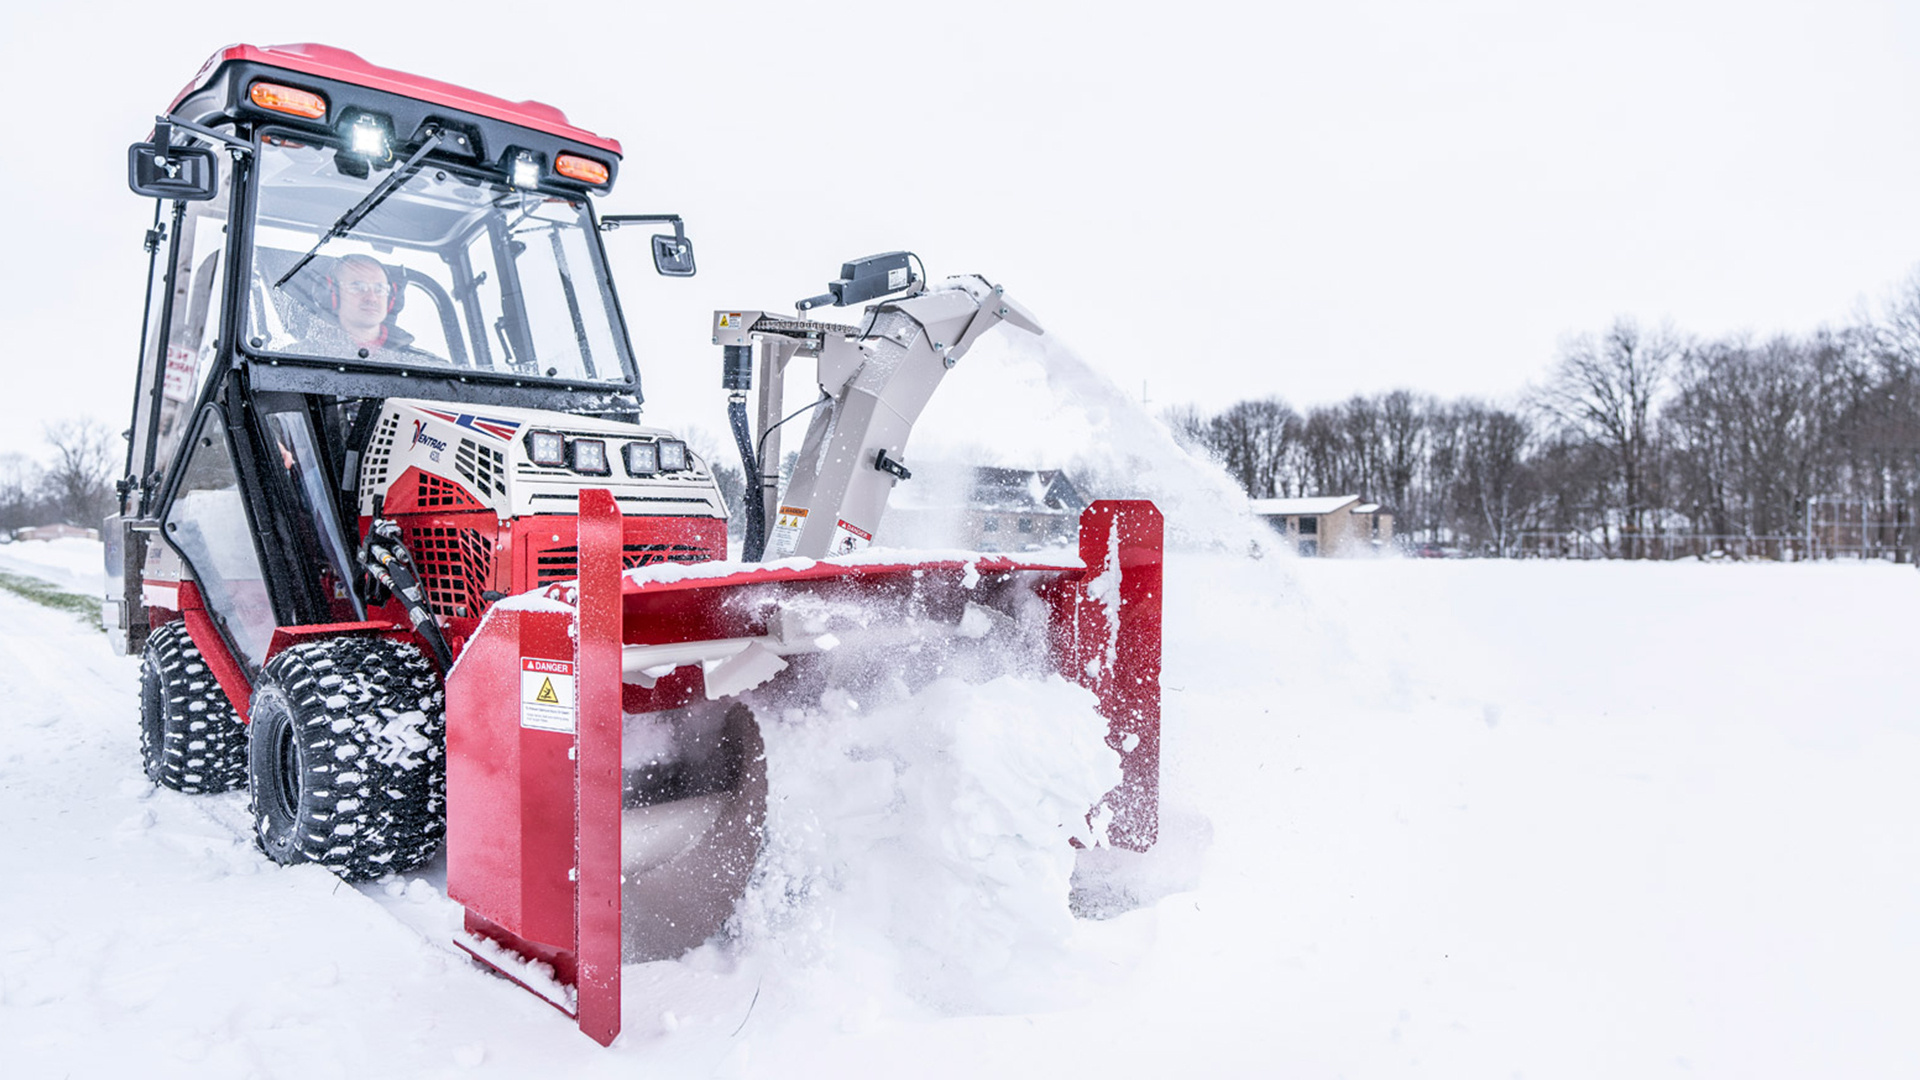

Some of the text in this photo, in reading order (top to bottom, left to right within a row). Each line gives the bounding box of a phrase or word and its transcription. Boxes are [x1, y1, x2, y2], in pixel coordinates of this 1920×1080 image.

[408, 419, 447, 452] VENTRAC
[846, 524, 868, 539] DANGER
[535, 661, 568, 673] DANGER
